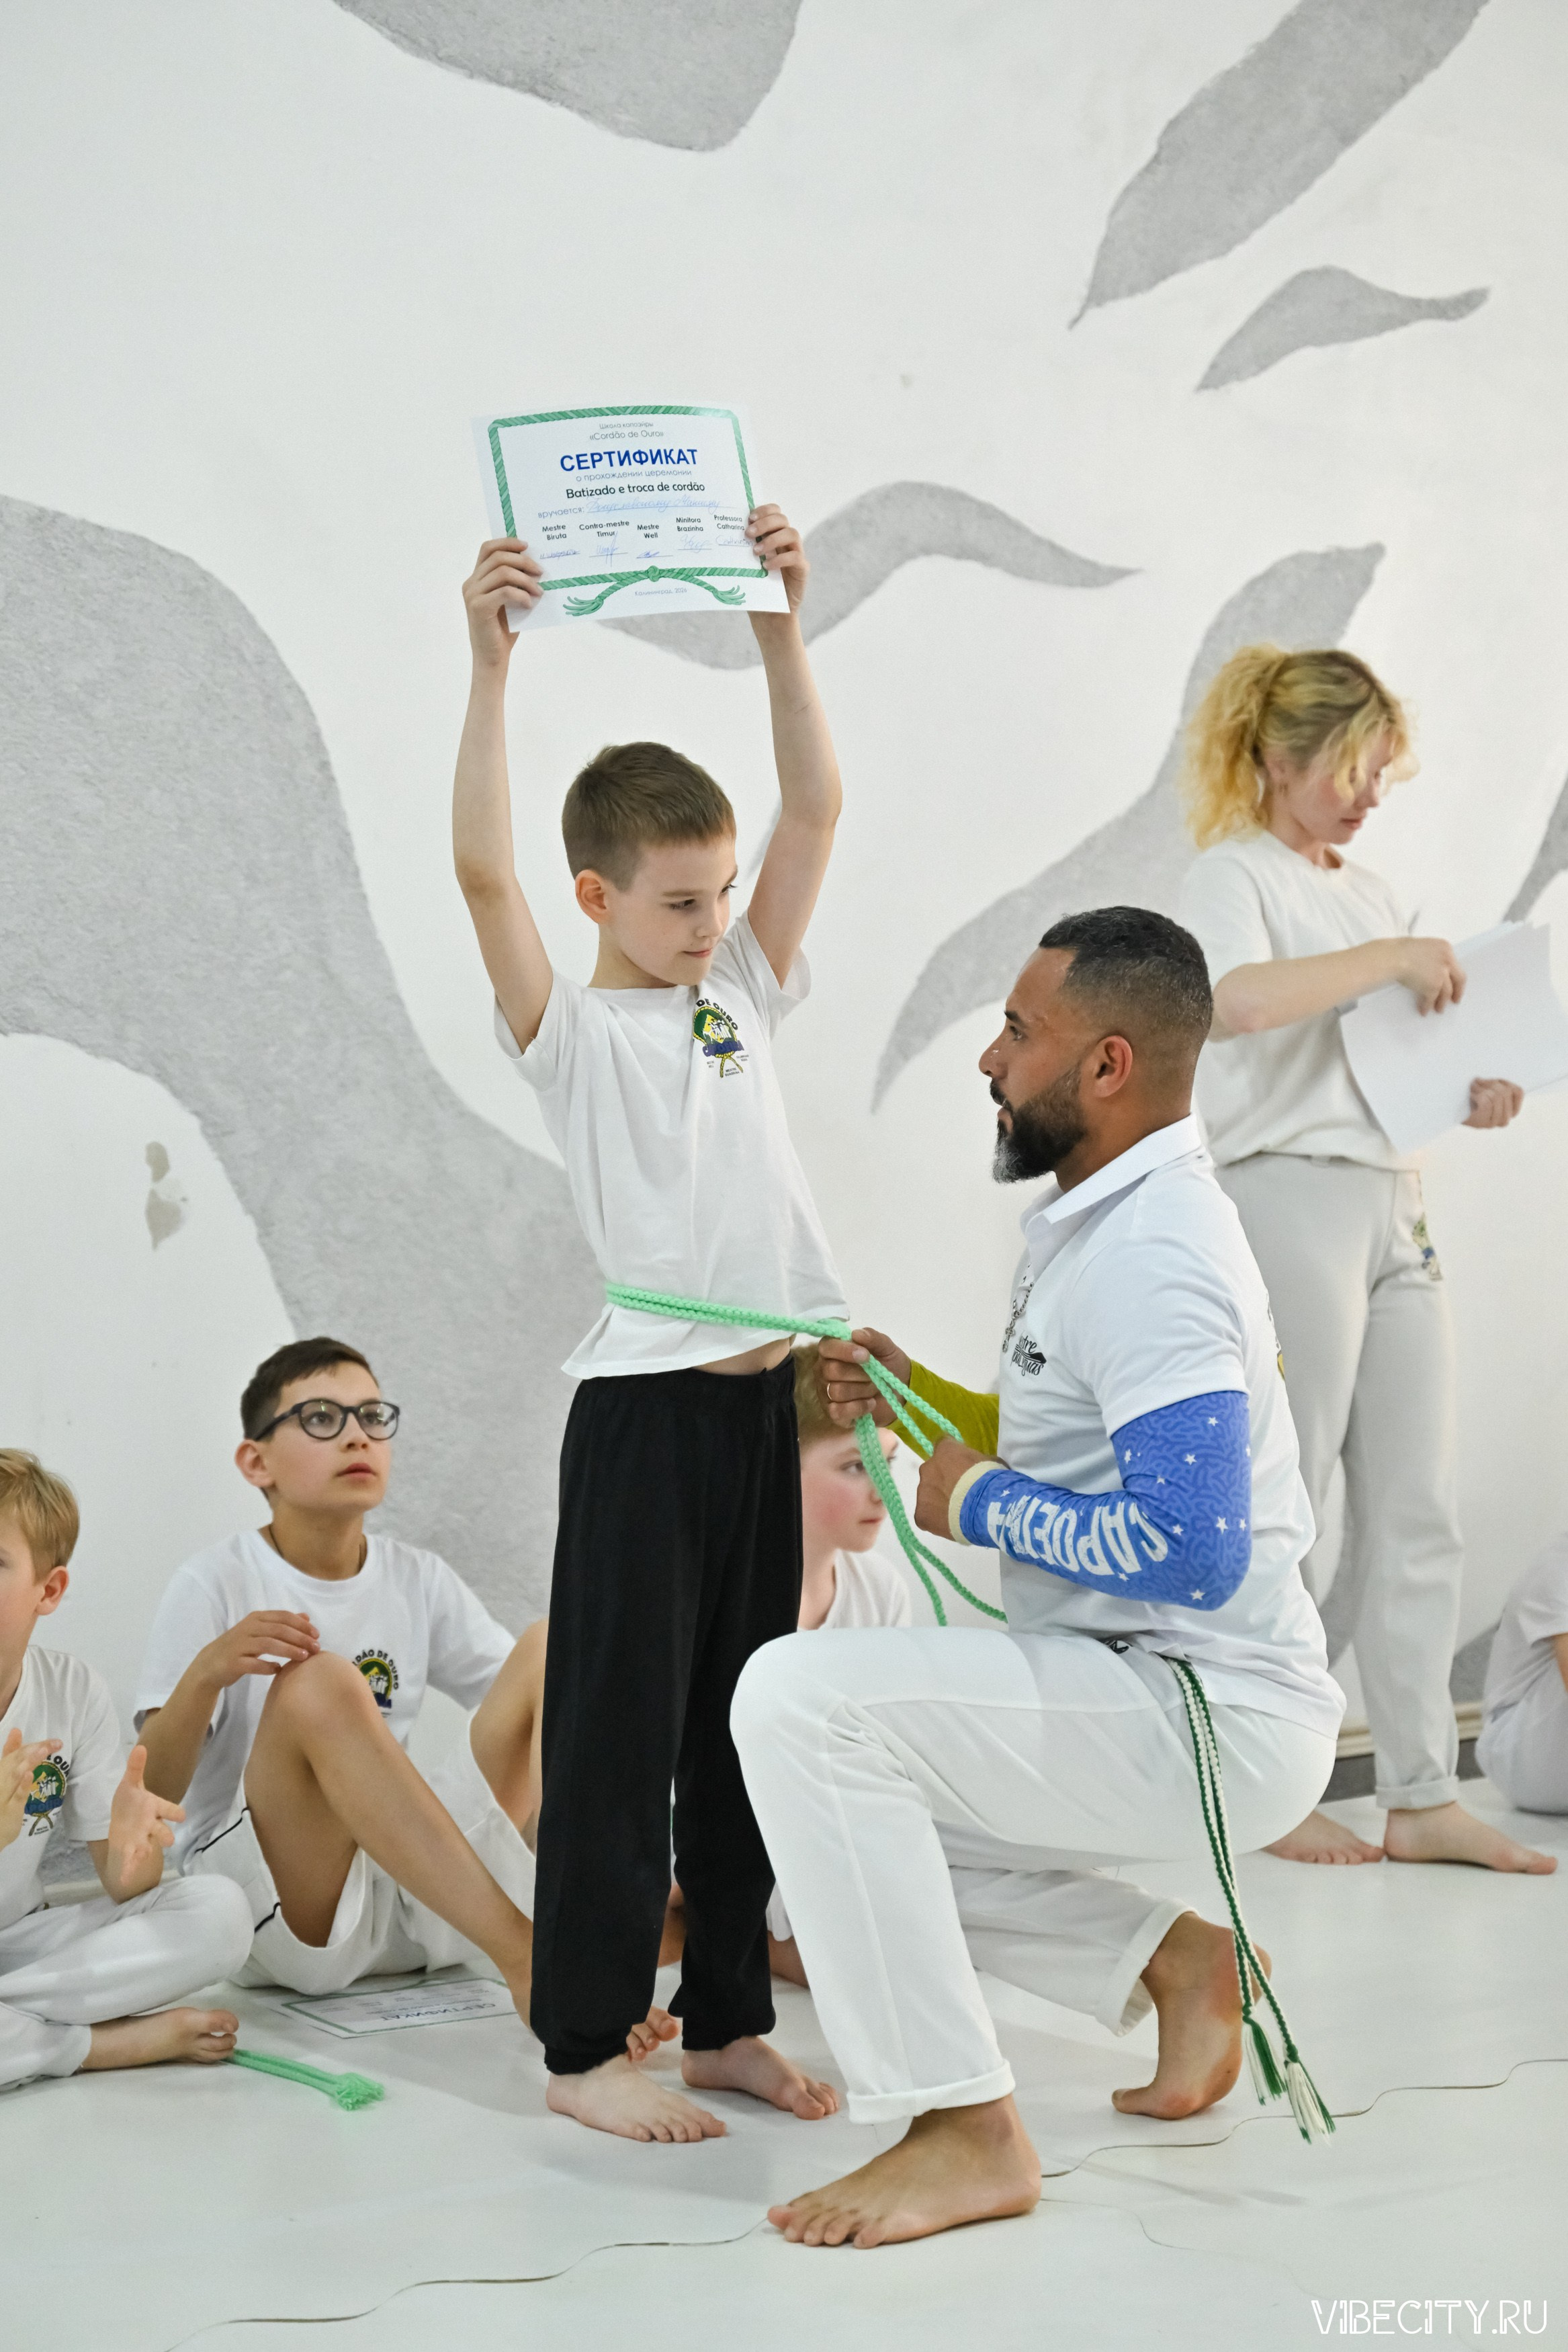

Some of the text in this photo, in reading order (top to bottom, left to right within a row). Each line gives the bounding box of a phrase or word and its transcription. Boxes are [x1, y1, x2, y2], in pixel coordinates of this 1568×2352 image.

[622, 421, 654, 429] капоэйры
[589, 431, 625, 440] «Cordão
[560, 448, 698, 472] СЕРТИФИКАТ
[584, 471, 643, 482] прохождении
[645, 469, 692, 478] церемонии
[566, 481, 705, 499] Batizado e troca de cordão
[538, 506, 584, 519] вручается:
[714, 515, 743, 523] Professora
[542, 523, 566, 532] Mestre
[579, 520, 630, 531] Contra-mestre
[716, 523, 745, 531] Catharina
[546, 533, 567, 541] Biruta
[696, 998, 738, 1030] DE OURO
[987, 1495, 1168, 1576] CAPOEIRA
[377, 1650, 388, 1661] DE
[388, 1659, 399, 1689] OURO
